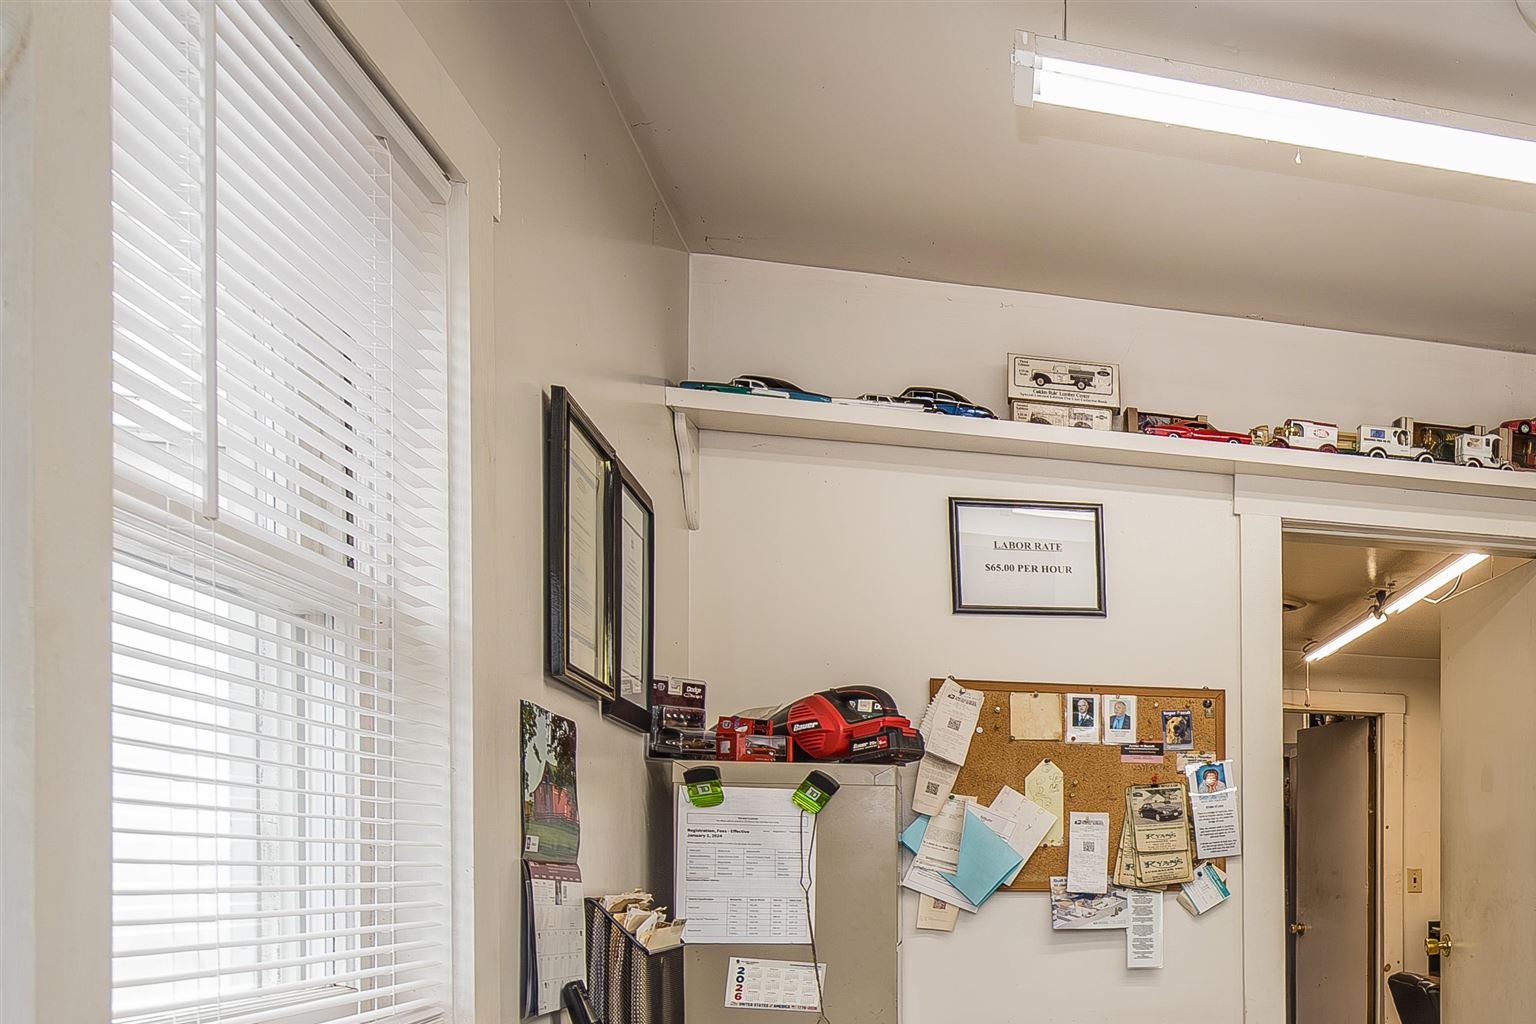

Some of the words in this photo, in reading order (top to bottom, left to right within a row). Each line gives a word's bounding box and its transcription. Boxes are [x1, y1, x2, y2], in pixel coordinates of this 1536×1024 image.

[993, 540, 1032, 551] LABOR
[1034, 542, 1063, 552] RATE
[984, 563, 1015, 573] $65.00
[1017, 564, 1039, 573] PER
[1041, 565, 1073, 575] HOUR
[686, 686, 702, 694] Dodge
[793, 722, 818, 731] Bauer
